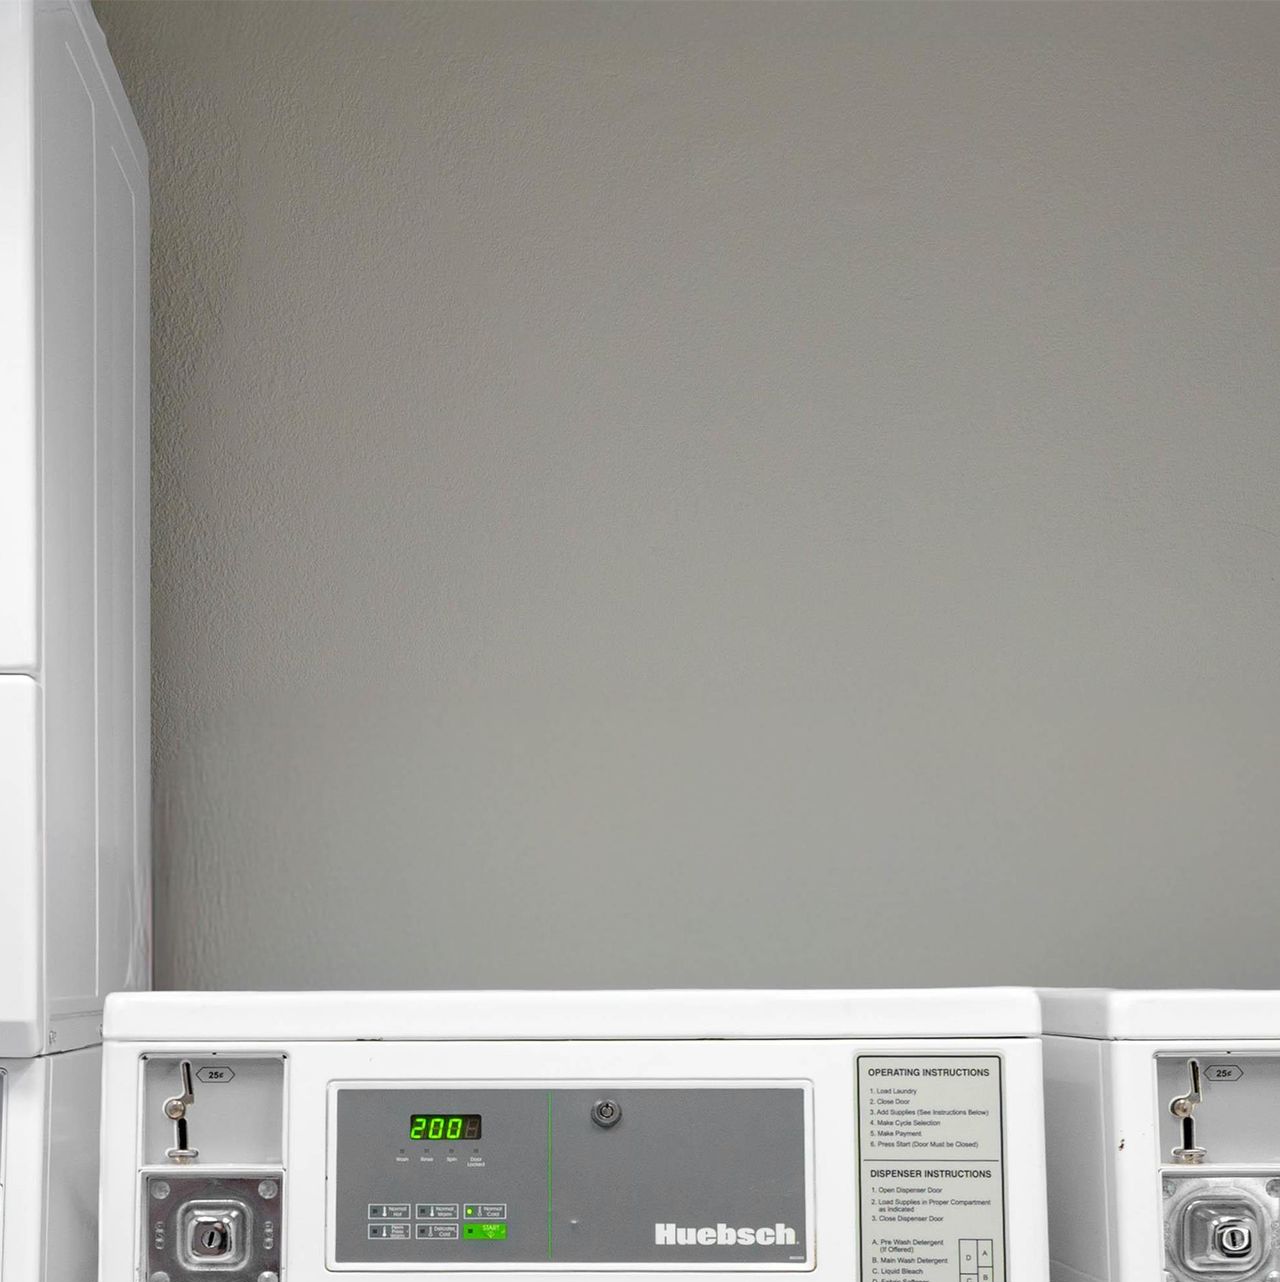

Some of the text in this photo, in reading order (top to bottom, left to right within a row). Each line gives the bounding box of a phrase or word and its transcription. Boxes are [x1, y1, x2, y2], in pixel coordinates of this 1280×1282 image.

[208, 1071, 224, 1080] 25¢
[868, 1068, 990, 1077] OPERATING INSTRUCTIONS
[1216, 1069, 1232, 1078] 25¢
[893, 1088, 917, 1096] Laundry
[890, 1109, 916, 1117] Supplies
[410, 1118, 463, 1139] 200
[895, 1130, 922, 1138] Payment
[870, 1169, 992, 1178] DISPENSER INSTRUCTIONS
[878, 1187, 895, 1195] Open
[896, 1187, 926, 1195] Dispenser
[895, 1199, 920, 1207] Supplies
[929, 1199, 949, 1207] Proper
[950, 1199, 991, 1207] Compartment
[655, 1223, 796, 1245] Huebsch
[887, 1246, 914, 1254] Offered)
[881, 1268, 900, 1276] Liquid
